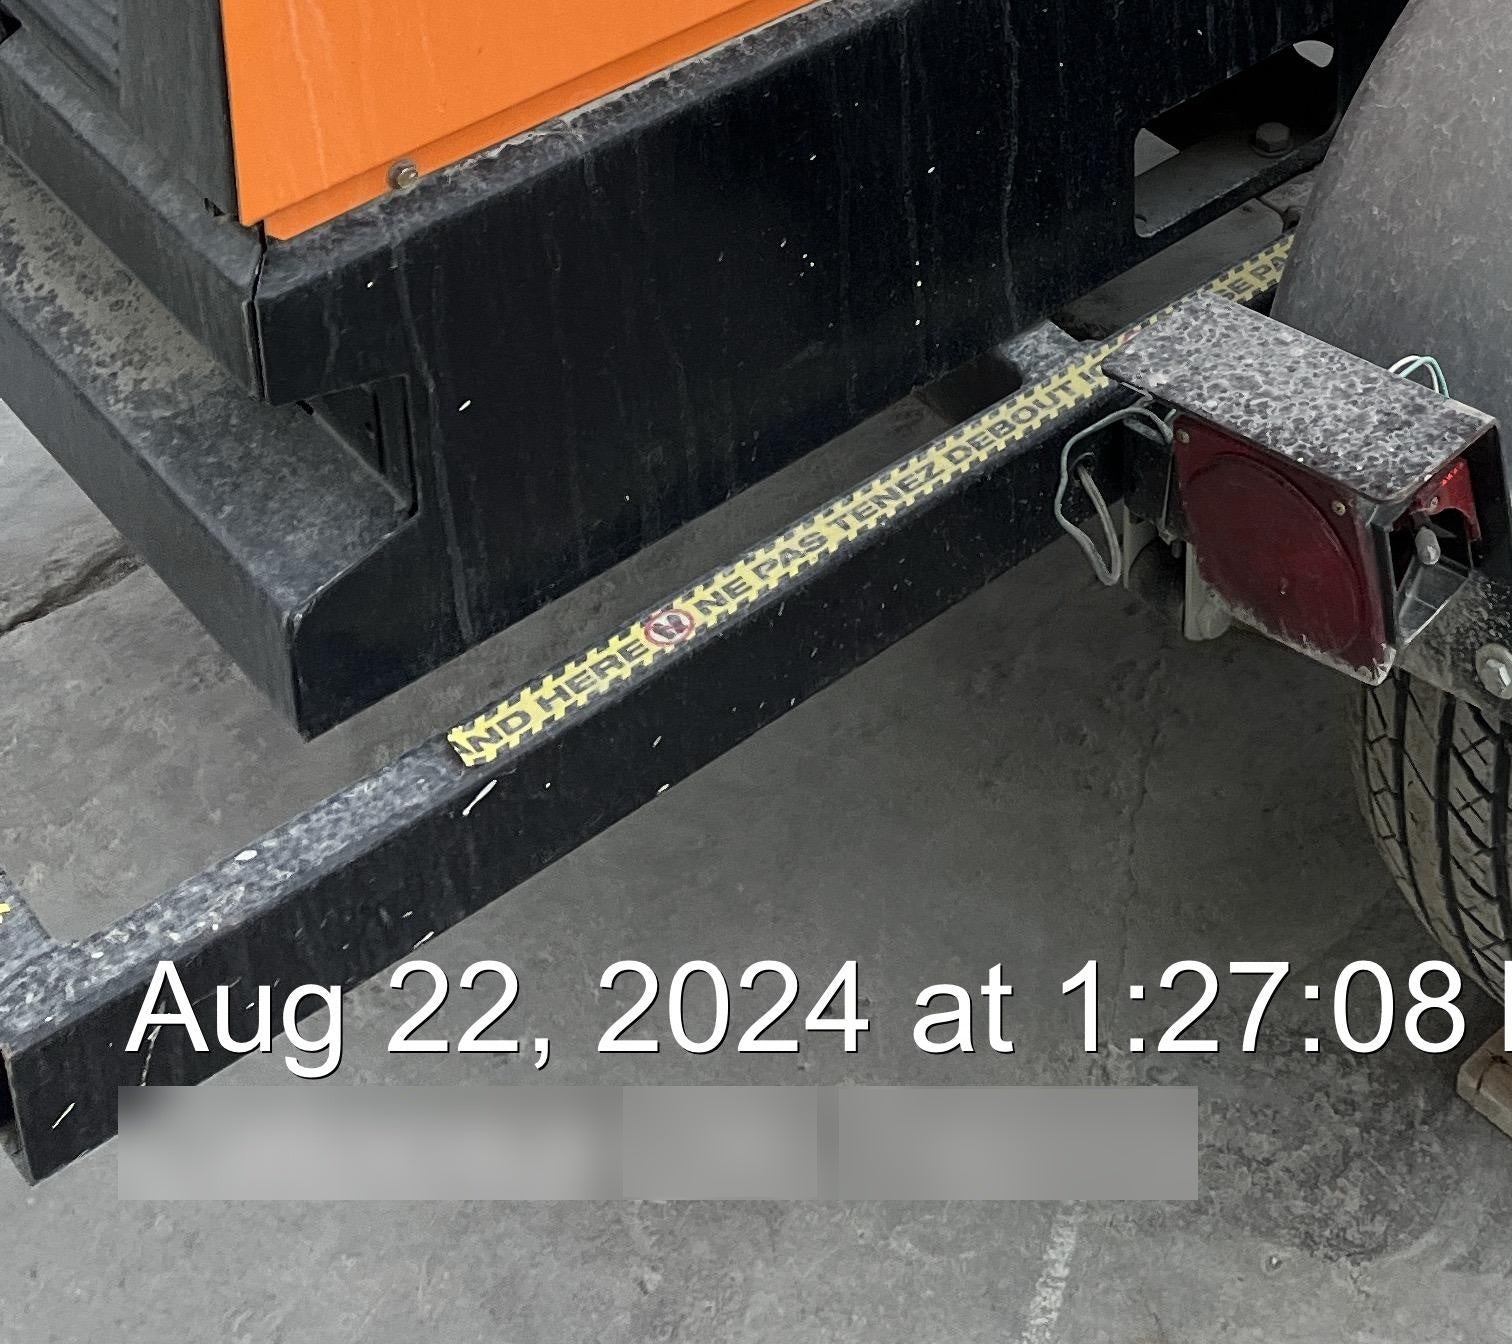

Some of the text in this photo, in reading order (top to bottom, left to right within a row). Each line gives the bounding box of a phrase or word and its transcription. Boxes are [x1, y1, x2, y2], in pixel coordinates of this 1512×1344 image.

[536, 638, 649, 711] HERE
[696, 576, 754, 616] NE
[752, 529, 829, 582] PAS
[826, 465, 946, 532] TENEZ
[946, 378, 1077, 467] DEBOUT
